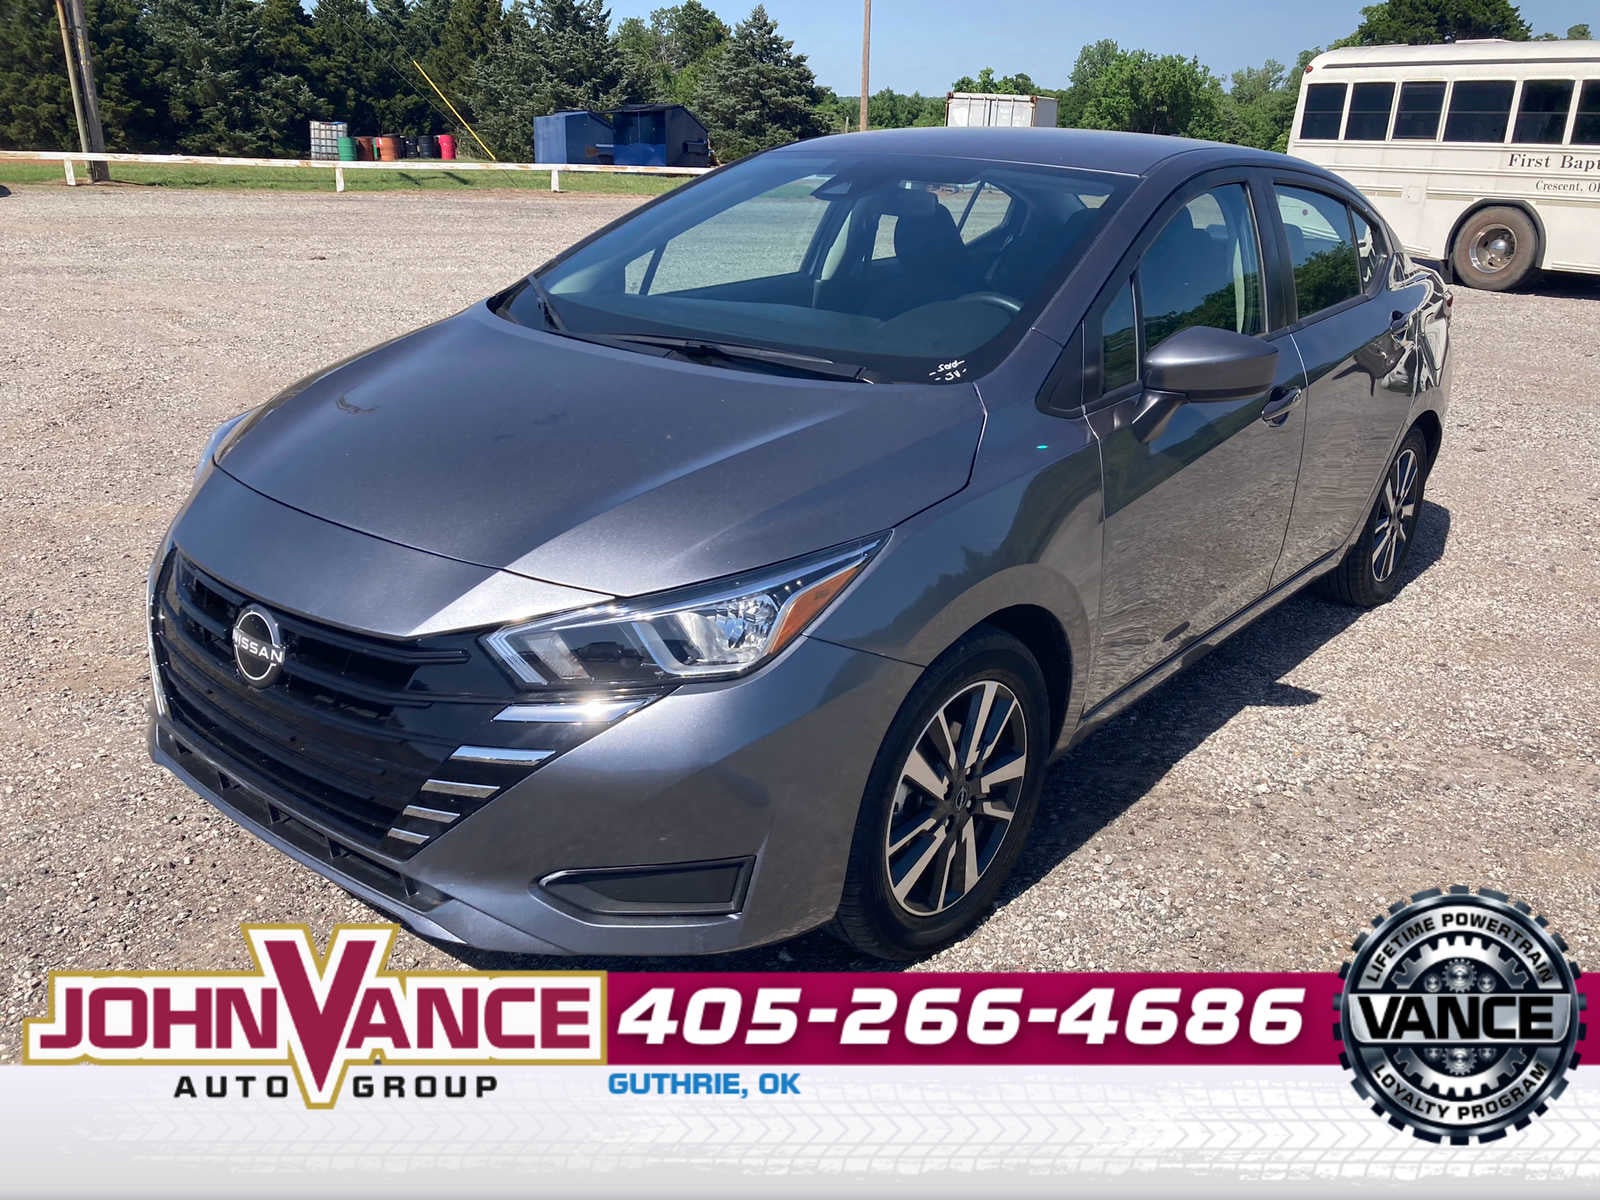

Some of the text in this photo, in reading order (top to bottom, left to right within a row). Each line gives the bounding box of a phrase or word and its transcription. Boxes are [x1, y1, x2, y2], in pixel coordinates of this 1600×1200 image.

[1508, 153, 1551, 169] First
[1535, 178, 1583, 192] Crescent,
[232, 628, 283, 663] NISSAN
